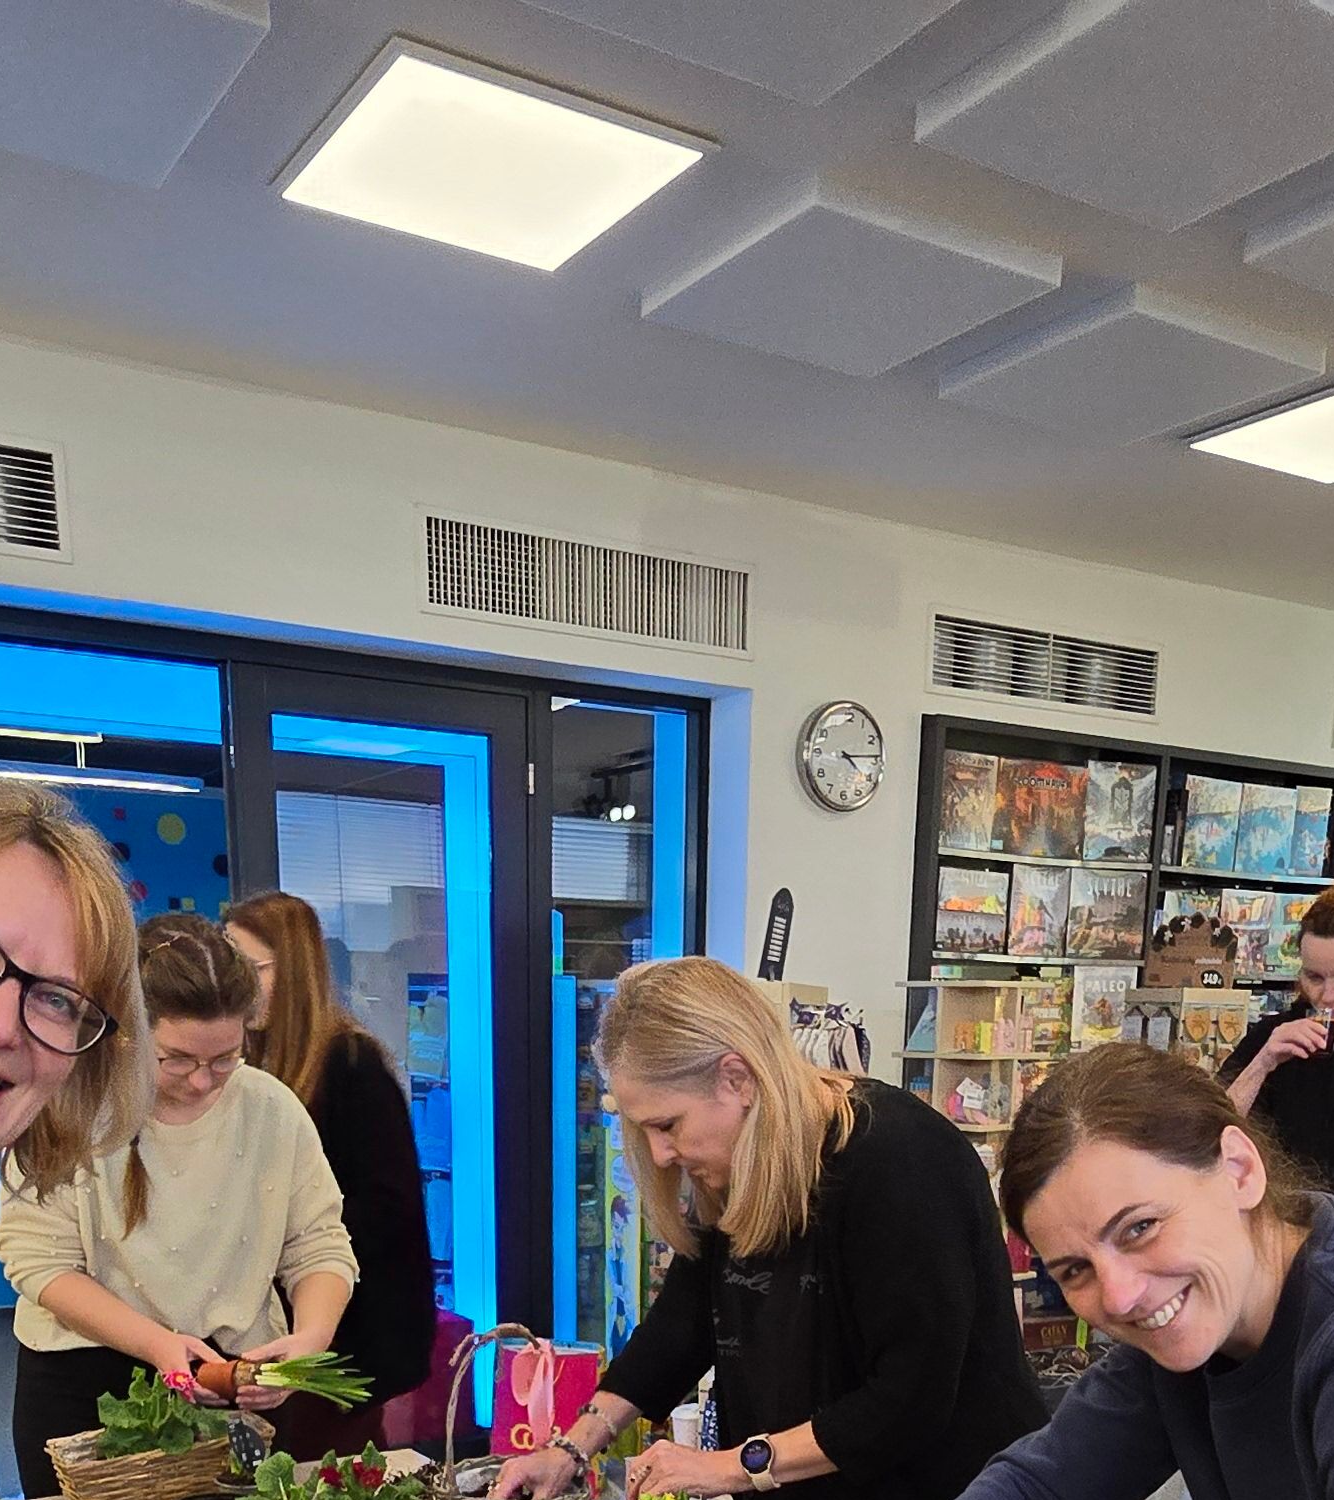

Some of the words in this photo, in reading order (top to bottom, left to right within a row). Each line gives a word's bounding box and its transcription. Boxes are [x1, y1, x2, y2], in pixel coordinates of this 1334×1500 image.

[867, 735, 876, 746] 2
[817, 768, 826, 778] 8
[826, 783, 834, 794] 7
[839, 790, 848, 801] 6
[1085, 980, 1126, 993] PALEO
